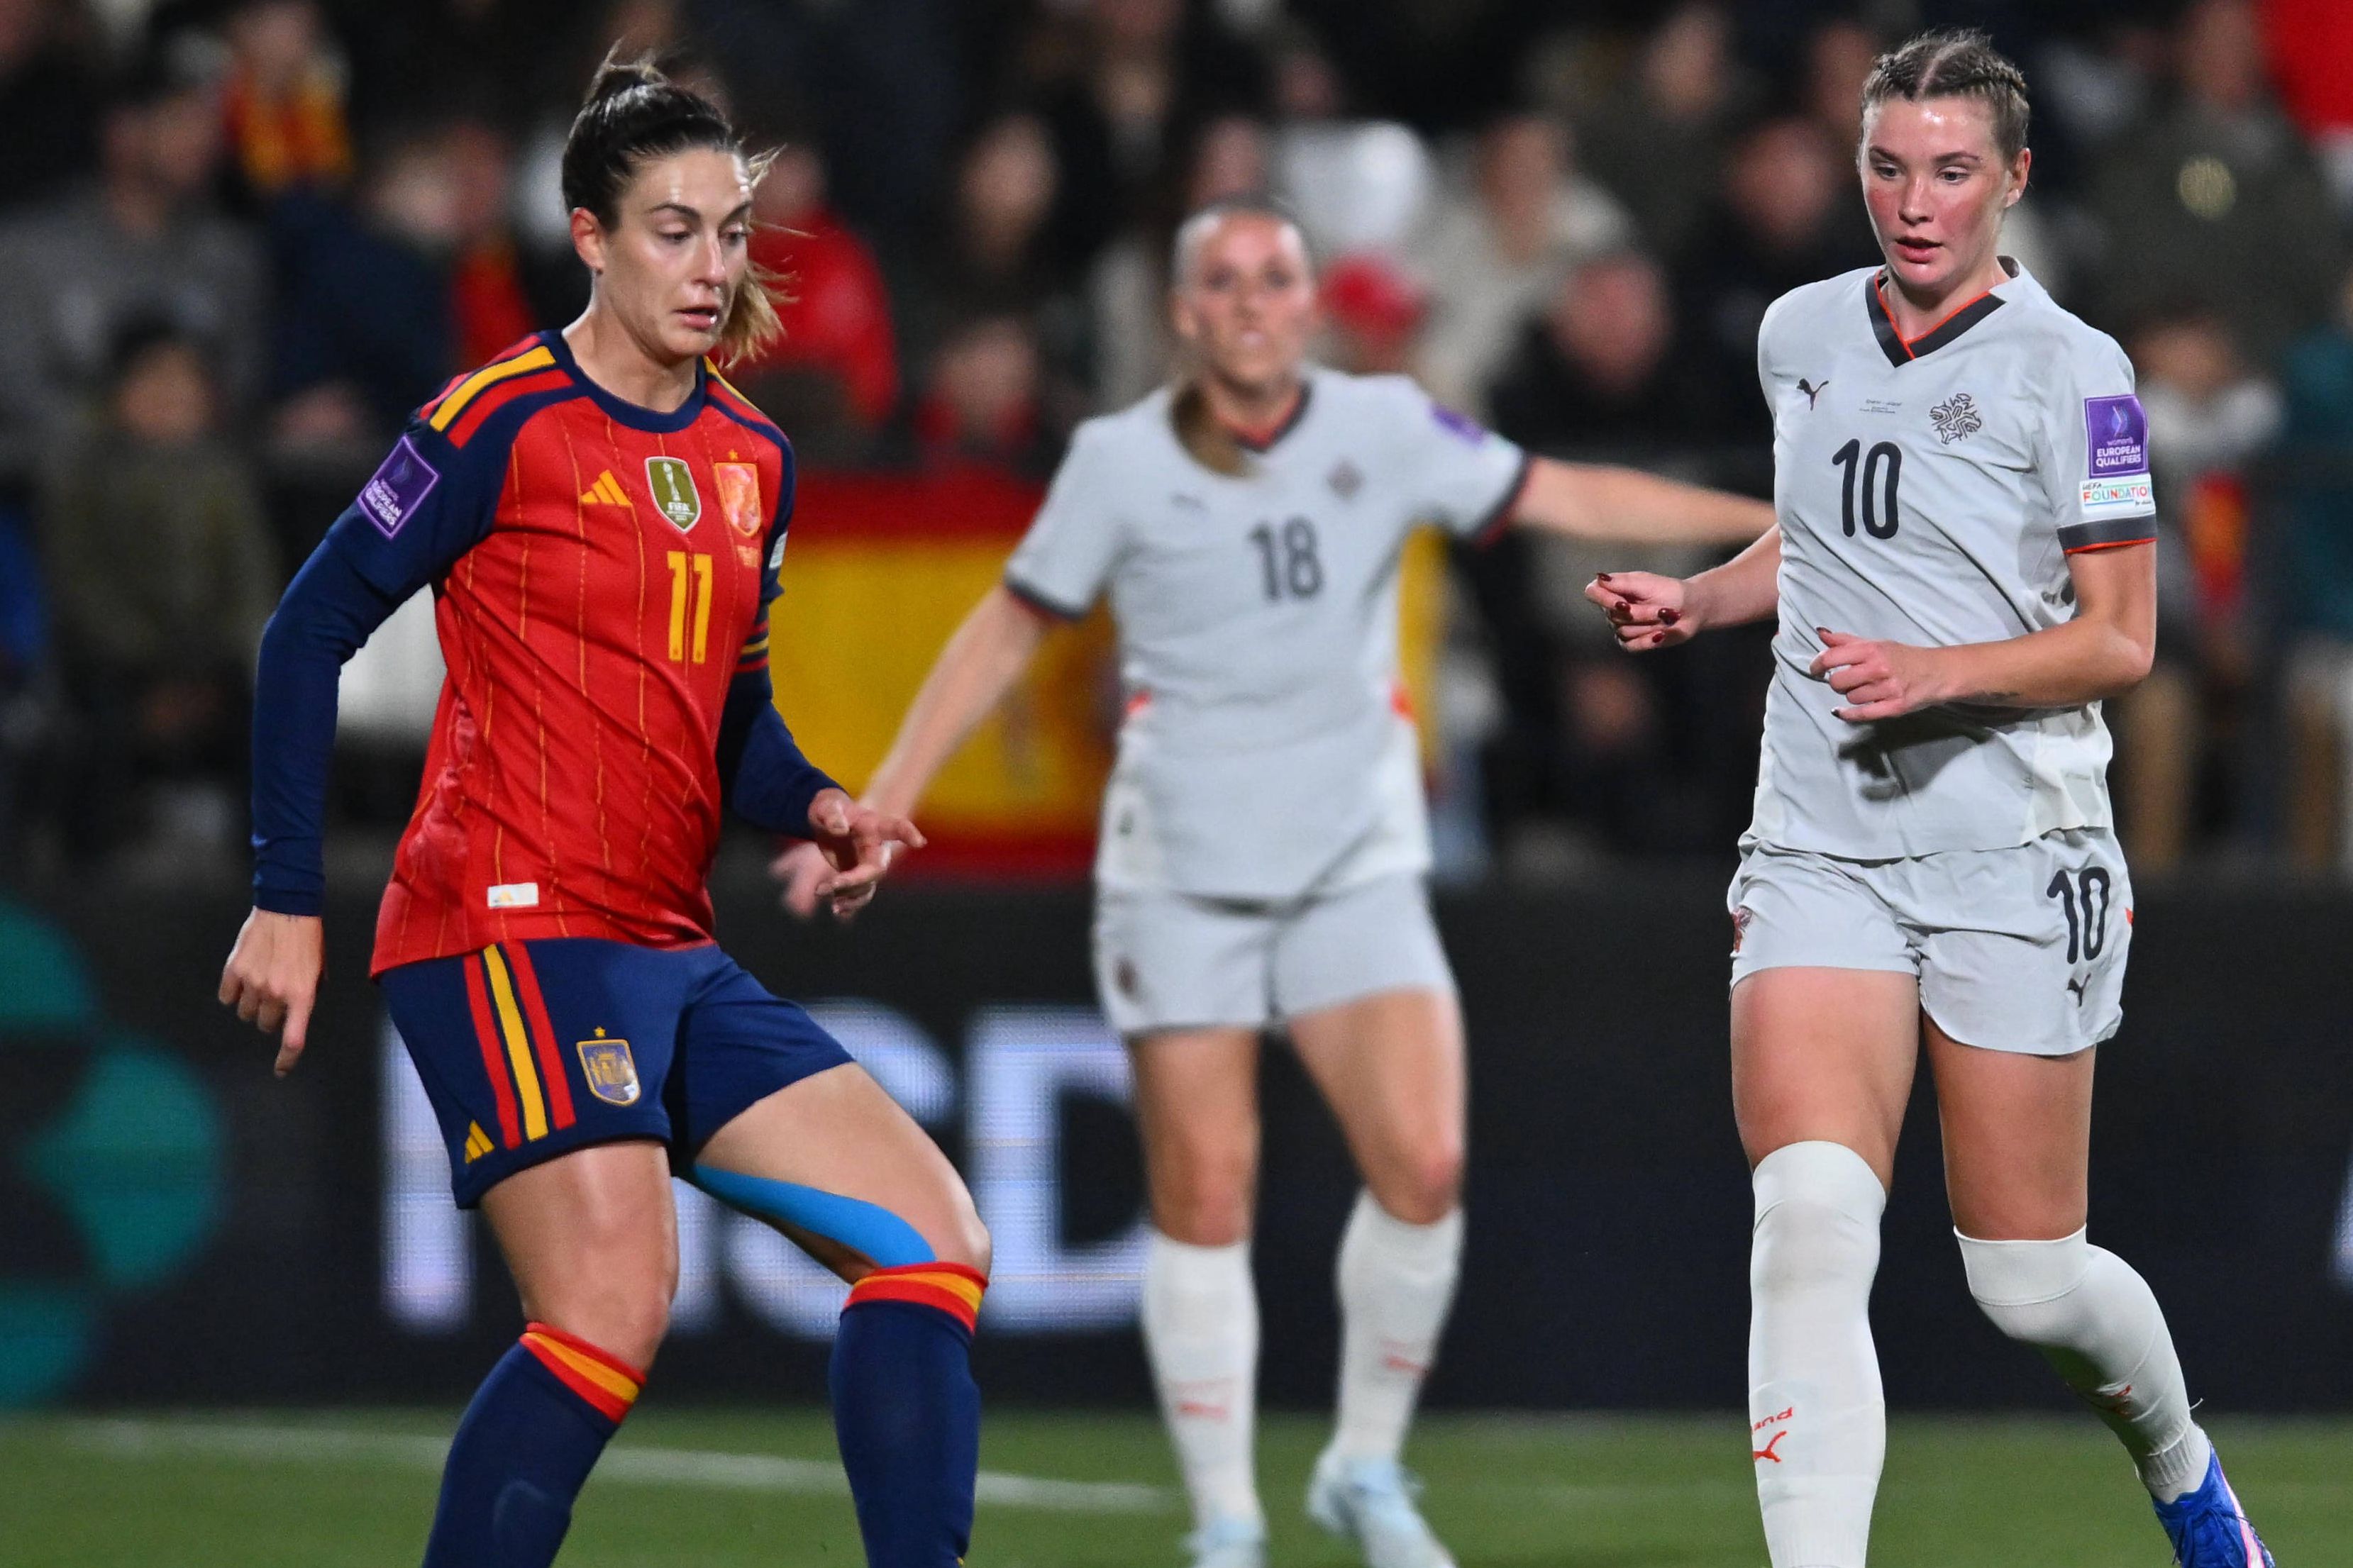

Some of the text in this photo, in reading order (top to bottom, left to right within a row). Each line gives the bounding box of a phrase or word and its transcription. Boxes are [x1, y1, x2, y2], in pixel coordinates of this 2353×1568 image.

[1832, 439, 1902, 539] 10
[2095, 454, 2141, 467] QUALIFIERS
[2097, 445, 2141, 457] EUROPEAN
[1248, 515, 1324, 601] 18
[667, 551, 712, 665] 11
[2047, 867, 2110, 964] 10
